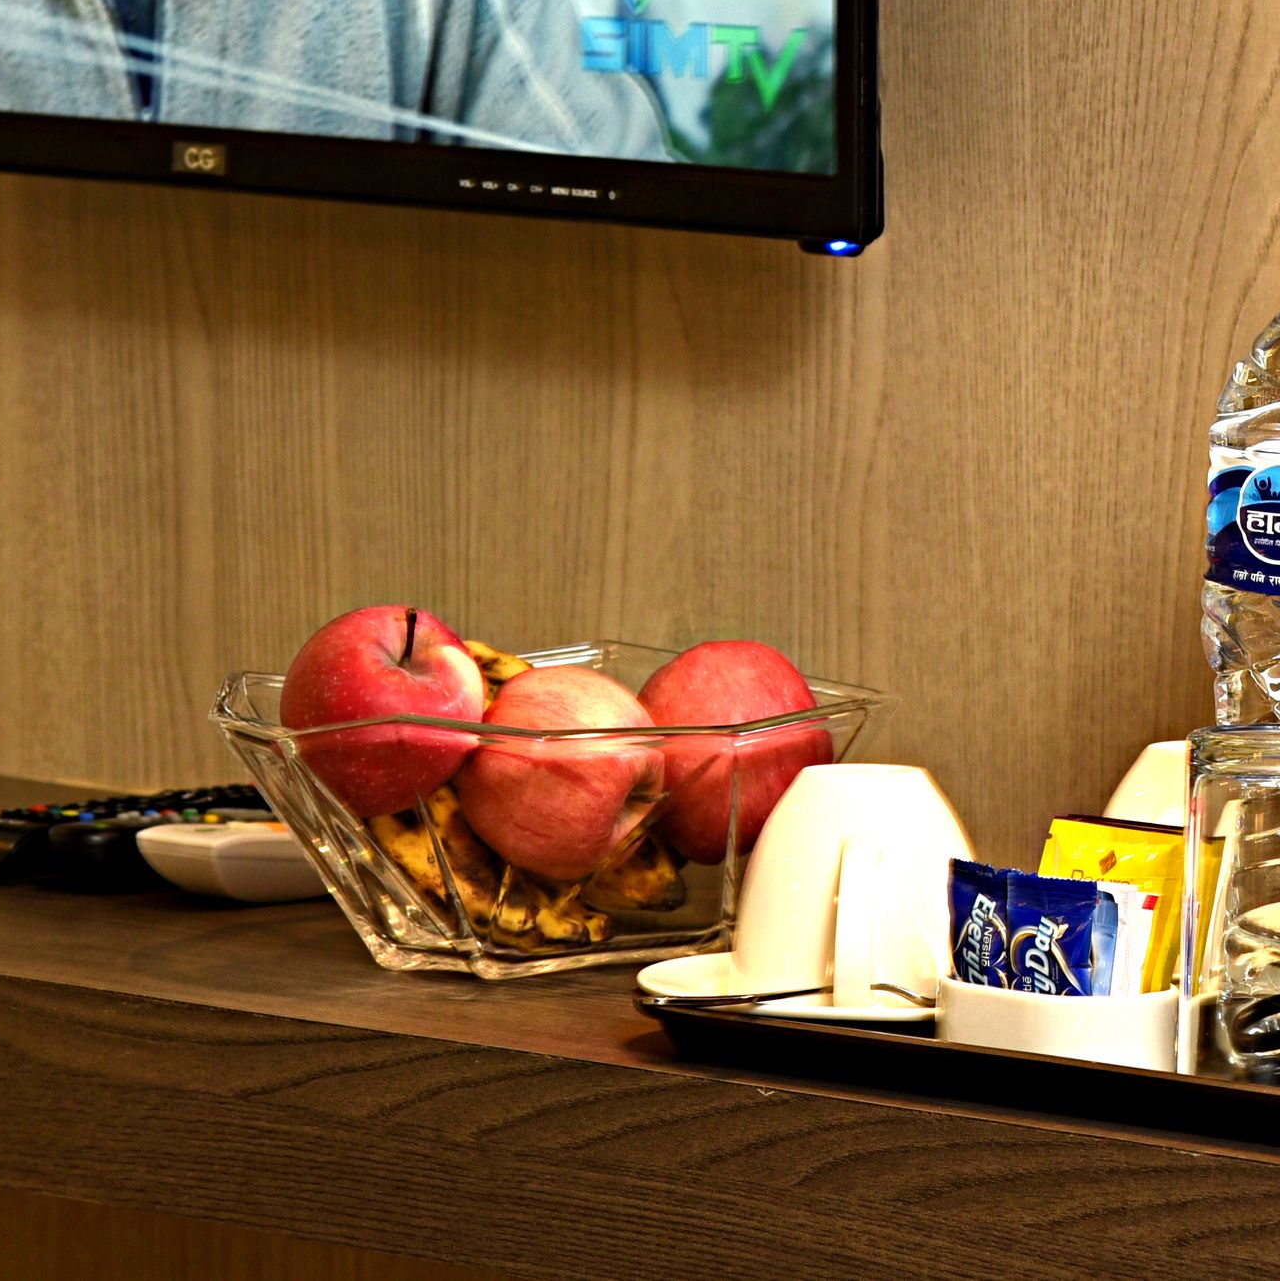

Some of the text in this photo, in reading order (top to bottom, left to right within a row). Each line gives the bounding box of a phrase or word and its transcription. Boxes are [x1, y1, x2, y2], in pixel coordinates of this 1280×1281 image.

[184, 147, 215, 170] CG
[551, 187, 569, 196] MENU
[572, 188, 598, 198] SOURCE
[1233, 569, 1248, 582] हाम्रो
[1250, 571, 1266, 584] पनि
